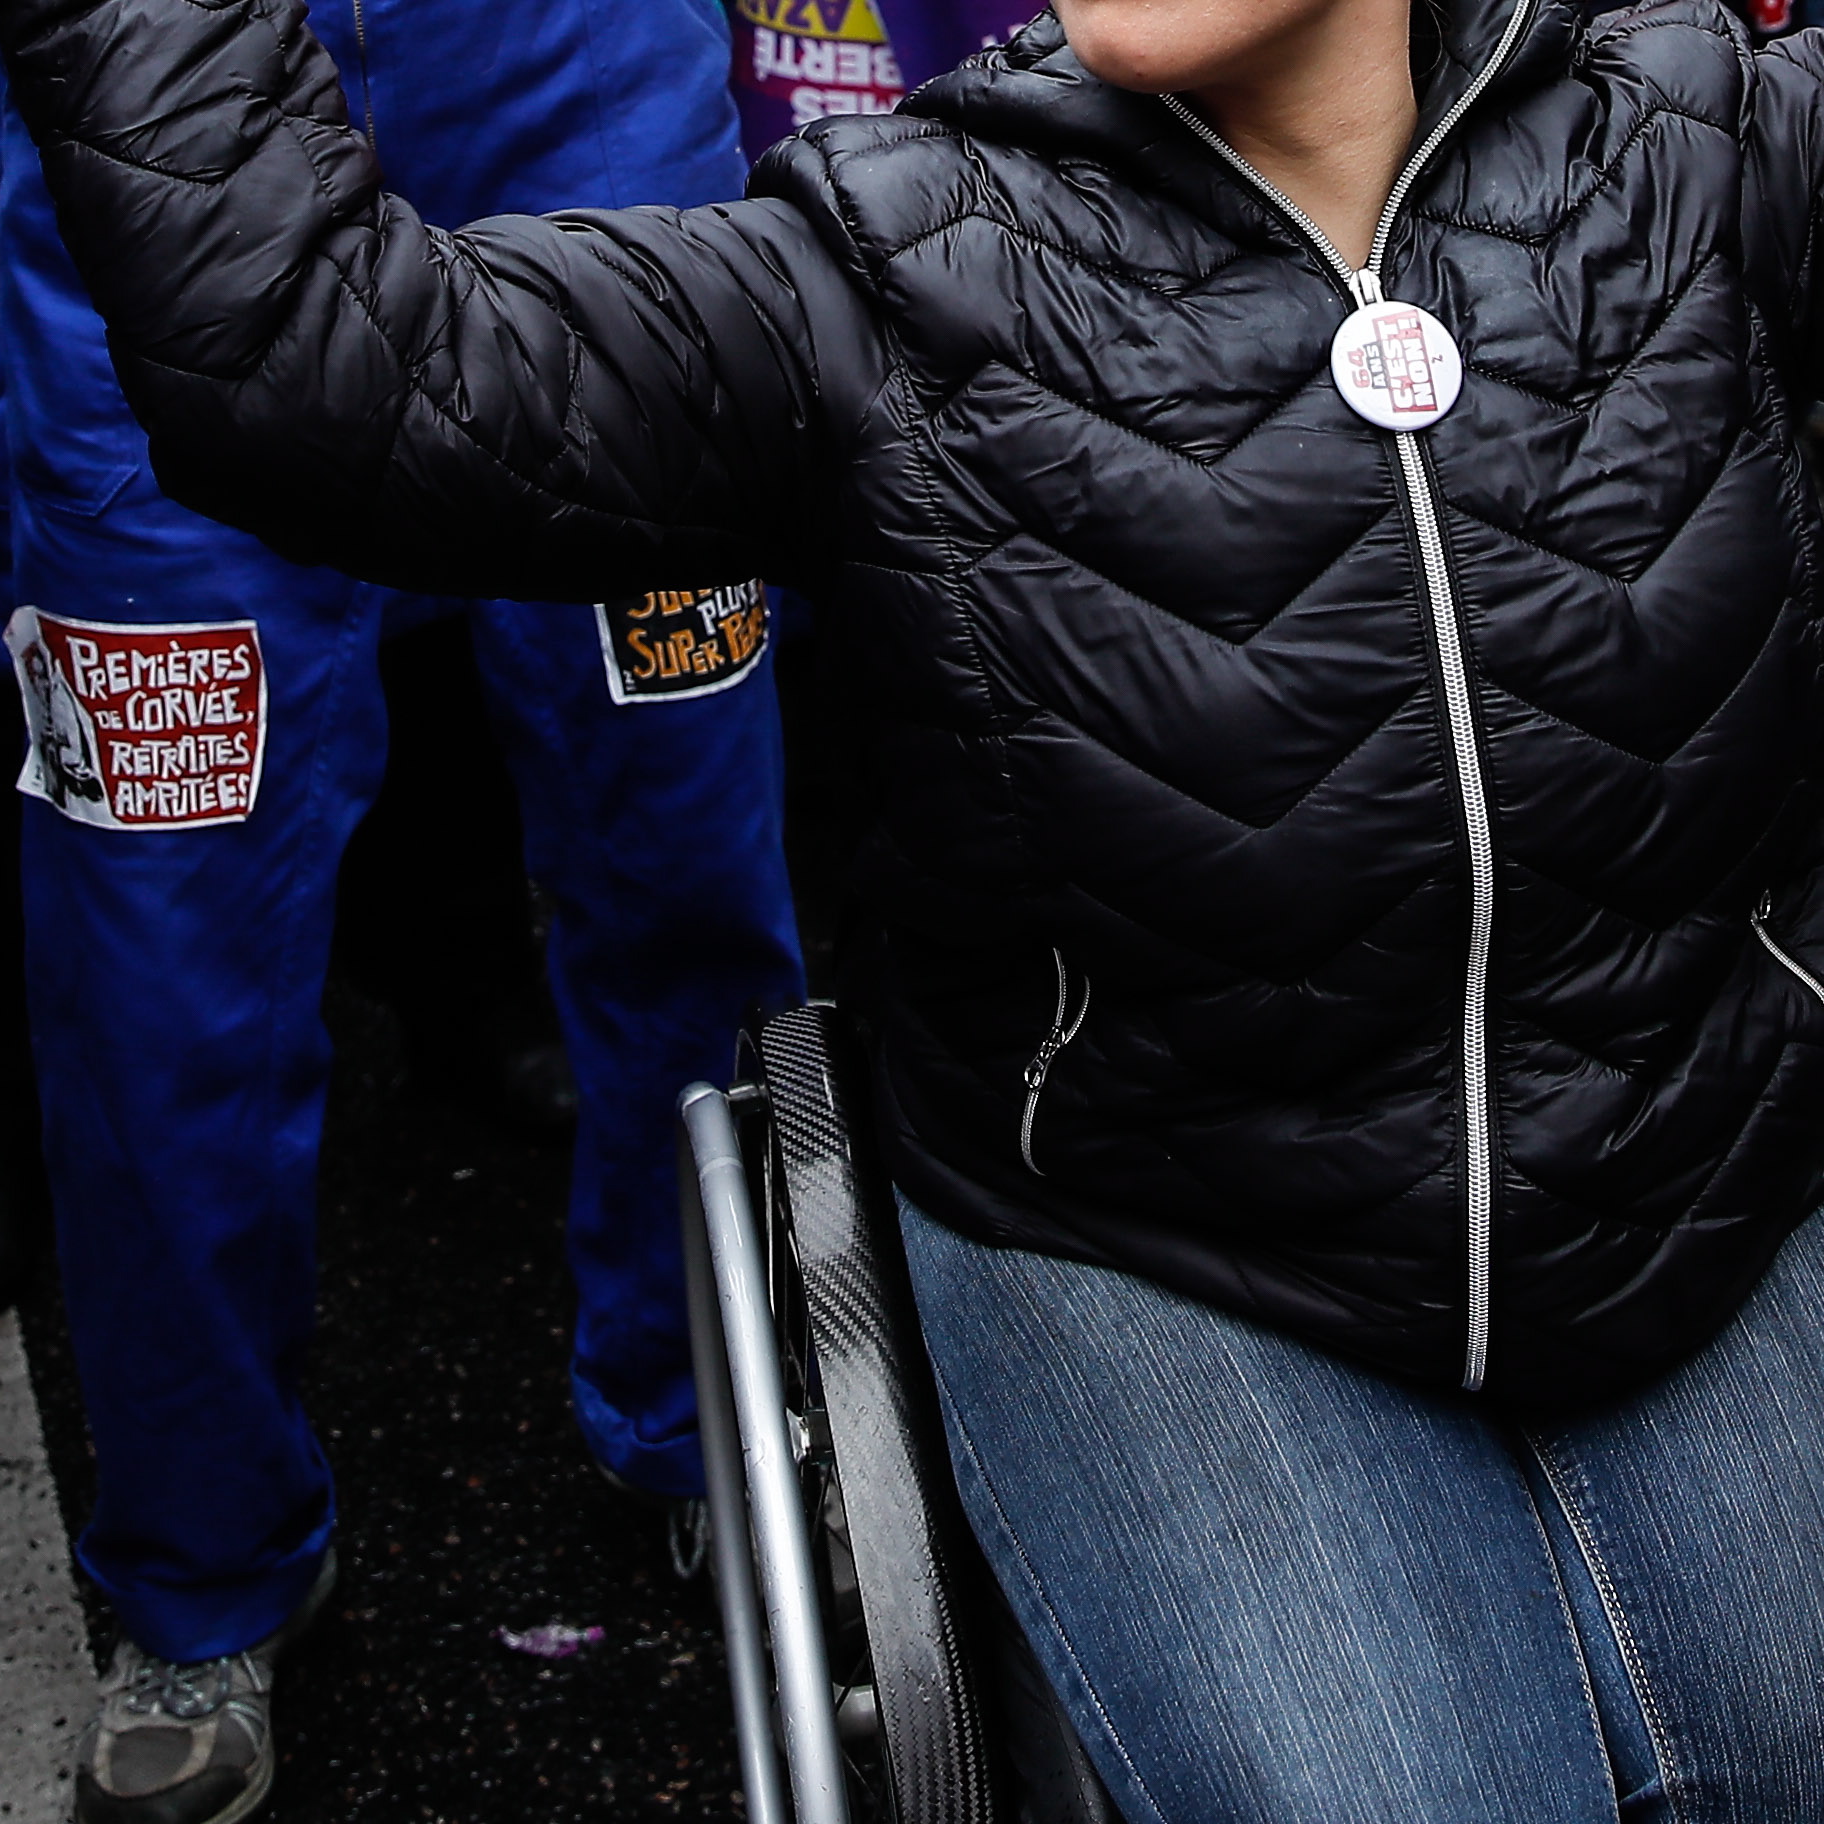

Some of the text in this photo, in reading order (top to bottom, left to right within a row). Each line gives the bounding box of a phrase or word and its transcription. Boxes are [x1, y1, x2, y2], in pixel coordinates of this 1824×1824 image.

[1346, 346, 1372, 389] 64
[1364, 343, 1388, 389] ANS
[1377, 320, 1414, 408] C'EST
[1401, 337, 1435, 408] NON
[627, 627, 726, 680] SUPER
[93, 681, 256, 733] DE CORVÉE,
